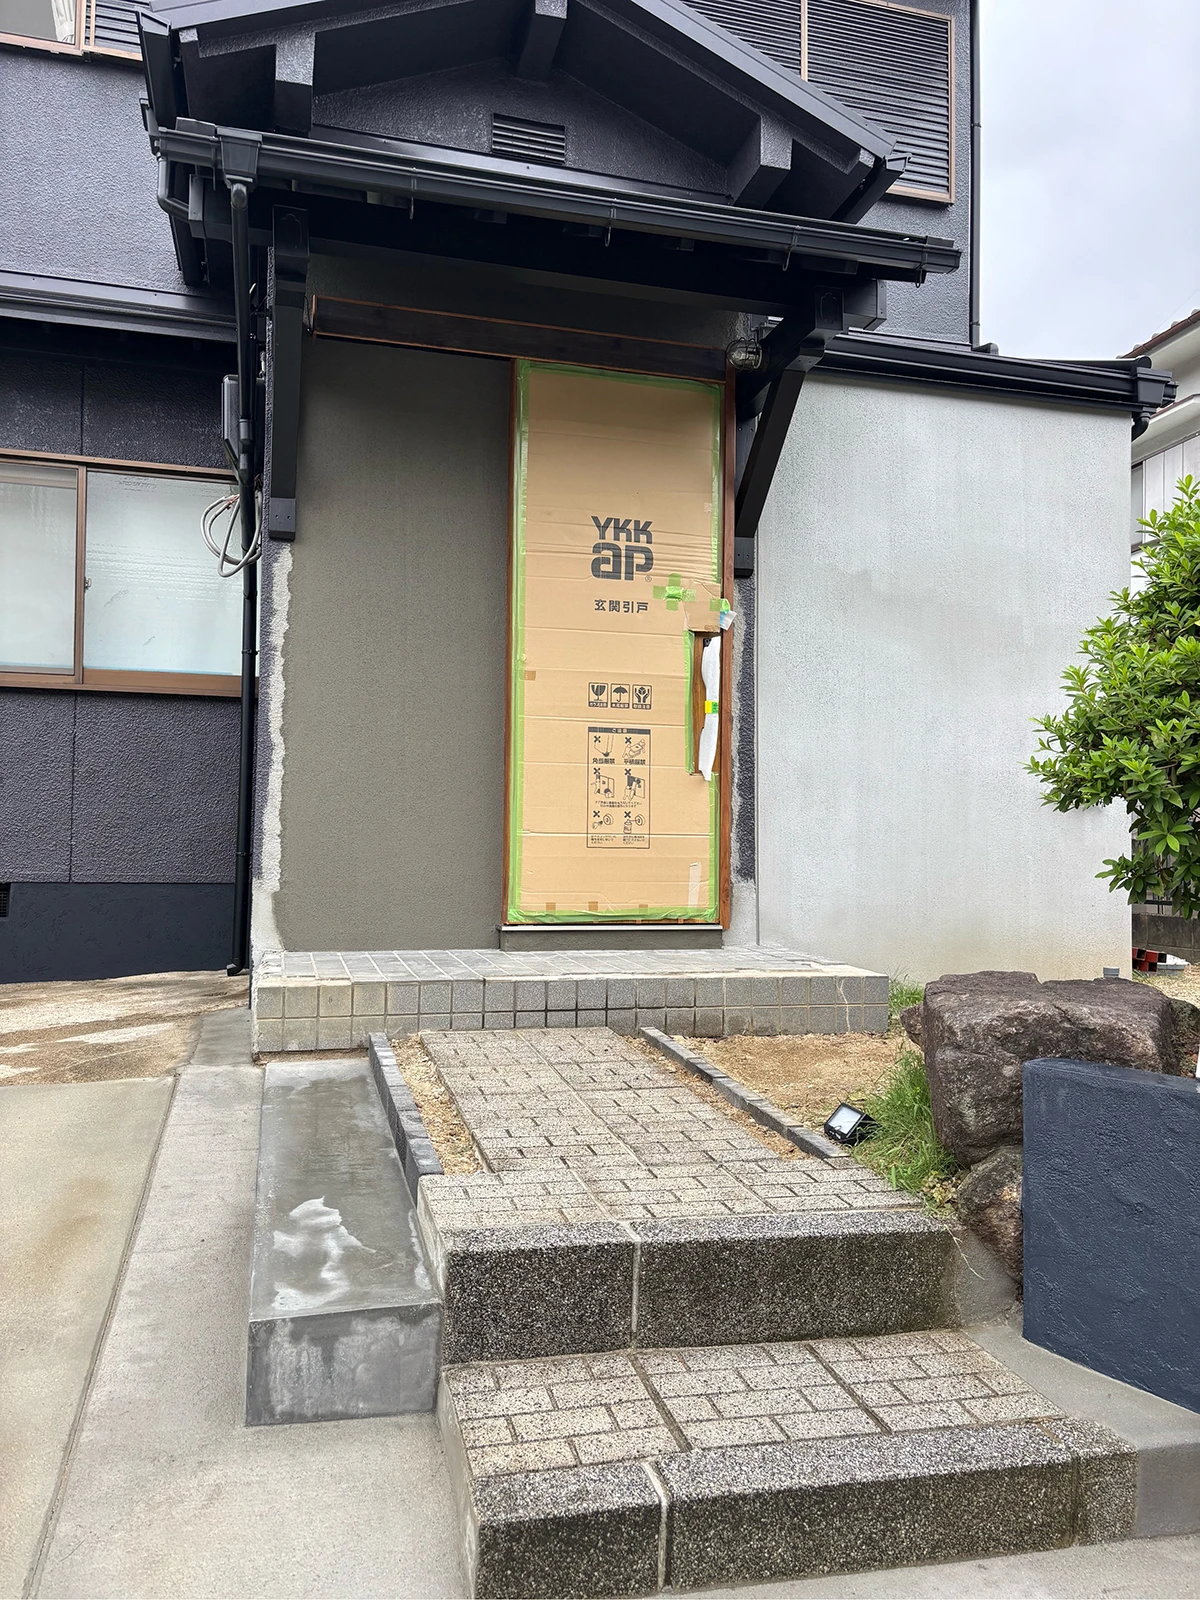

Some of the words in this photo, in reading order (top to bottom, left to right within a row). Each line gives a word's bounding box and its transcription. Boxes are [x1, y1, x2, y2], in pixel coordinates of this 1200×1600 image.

[591, 516, 653, 544] YKK
[591, 542, 654, 581] ap
[594, 599, 649, 613] 玄関引戸
